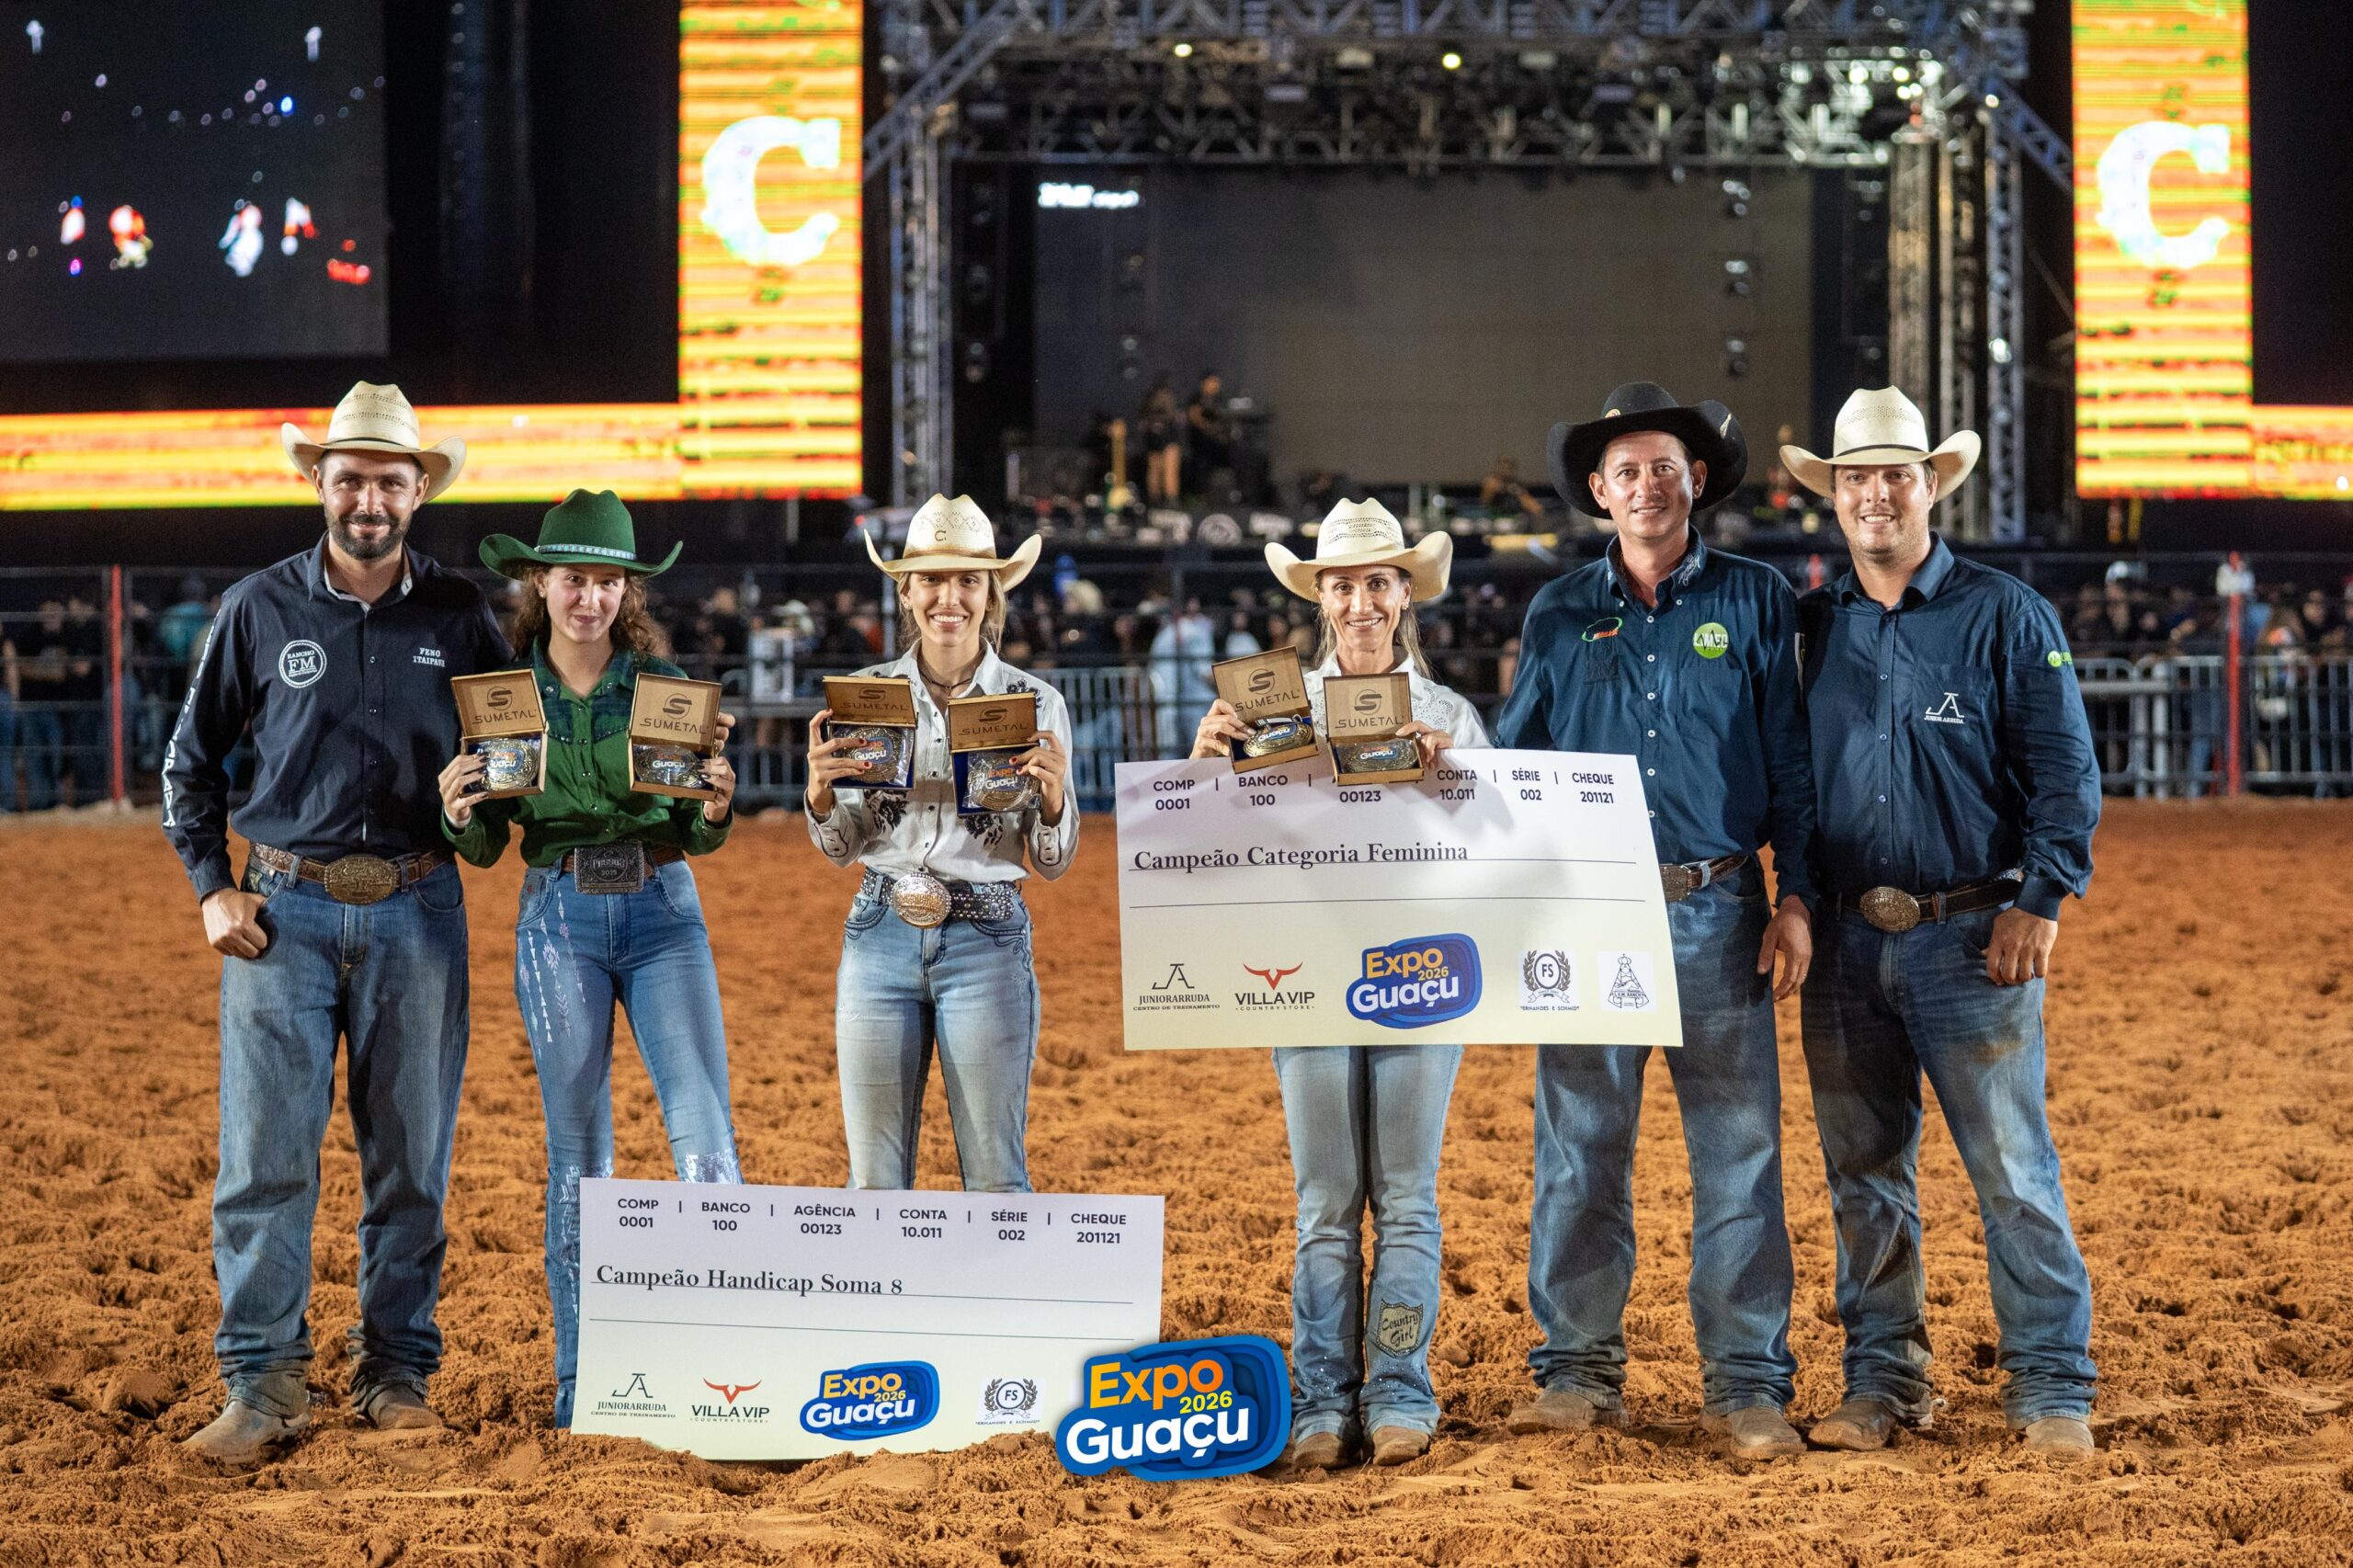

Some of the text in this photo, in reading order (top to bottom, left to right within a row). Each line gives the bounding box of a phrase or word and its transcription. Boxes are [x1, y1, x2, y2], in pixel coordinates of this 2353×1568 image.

[288, 655, 316, 671] FM
[839, 701, 909, 711] SUMETAL
[1234, 690, 1301, 711] SUMETAL
[472, 710, 536, 724] SUMETAL
[1335, 717, 1404, 729] SUMETAL
[640, 718, 707, 734] SUMETAL
[958, 723, 1028, 736] SUMETAL
[1153, 778, 1196, 791] COMP
[1238, 774, 1289, 788] BANCO
[1437, 769, 1478, 782] CONTA
[1512, 767, 1541, 782] SÉRIE
[1572, 772, 1614, 785] CHEQUE
[1155, 789, 1614, 811] 0001 100 00123 10.011 002 201121
[1134, 842, 1469, 873] Campeão Categoria Feminina
[1366, 948, 1443, 980] Expo
[1541, 963, 1554, 978] FS
[1417, 966, 1449, 981] 2026
[1234, 992, 1315, 1006] VILLA VIP
[1352, 976, 1459, 1013] Guaçu
[618, 1198, 1127, 1225] COMP BANCO AGÊNCIA CONTA SÉRIE CHEQUE
[619, 1216, 1121, 1244] 0001 100 00123 10.011 002 201121
[597, 1265, 903, 1297] Campeão Handicap Soma 8
[1381, 1314, 1418, 1331] Country
[1391, 1325, 1414, 1346] Girl
[824, 1372, 903, 1400] Expo
[873, 1390, 906, 1403] 2026
[1005, 1389, 1018, 1402] FS
[691, 1405, 770, 1418] VILLA VIP
[806, 1399, 915, 1428] Guaçu
